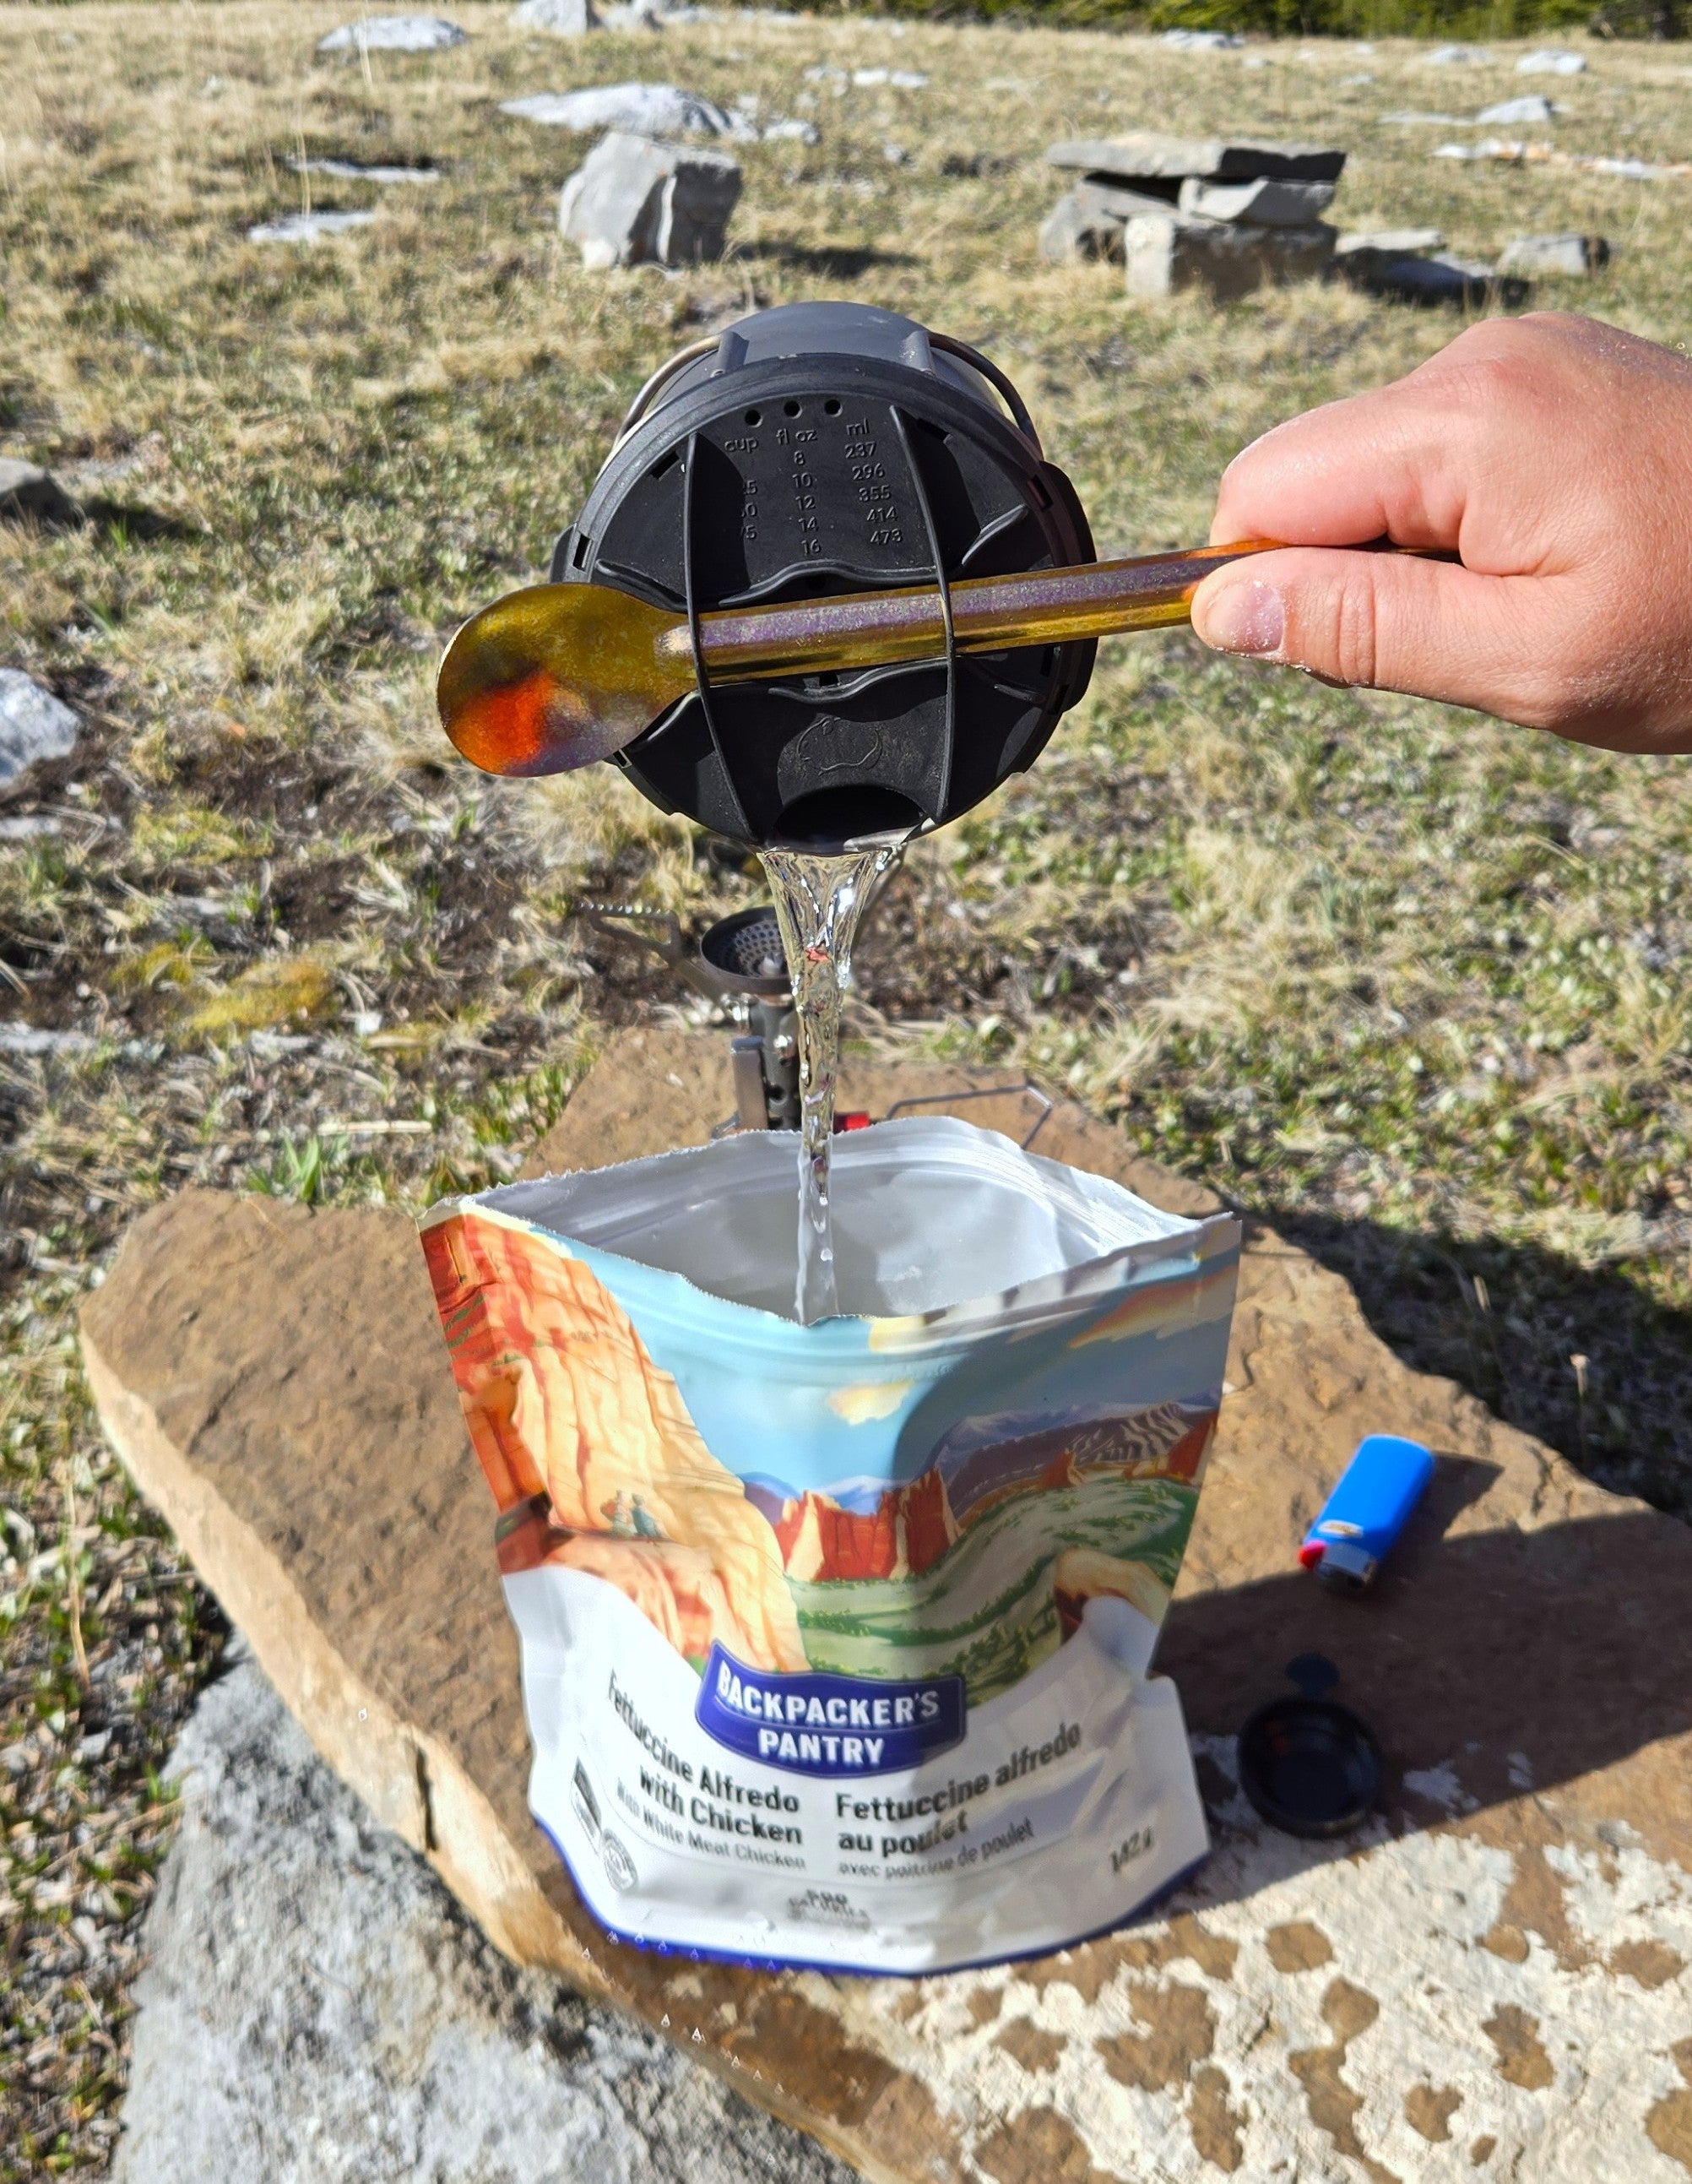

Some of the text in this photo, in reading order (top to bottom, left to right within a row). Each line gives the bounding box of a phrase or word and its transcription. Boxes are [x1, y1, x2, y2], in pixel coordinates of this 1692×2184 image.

[724, 436, 758, 454] cup
[795, 429, 817, 443] oz
[845, 417, 870, 436] ml
[793, 441, 876, 465] 8 237
[792, 472, 813, 488] 10
[851, 463, 885, 481] 296
[794, 495, 816, 511] 12
[858, 485, 892, 502] 355
[798, 516, 819, 533] 14
[866, 507, 898, 523] 414
[801, 529, 903, 557] 16 473
[716, 1659, 940, 1726] BACKPACKER'S
[608, 1667, 693, 1783] Fettuccine
[699, 1764, 800, 1812] Alfredo
[758, 1728, 885, 1766] PANTRY
[835, 1720, 1082, 1821] Fettuccine alfredo
[639, 1764, 684, 1817] with
[691, 1796, 803, 1844] Chicken
[687, 1830, 730, 1857] Meat
[735, 1844, 806, 1869] Chicken
[838, 1809, 968, 1858] au poulet
[838, 1861, 882, 1877] avec
[958, 1844, 978, 1867] de
[981, 1817, 1035, 1859] poulet
